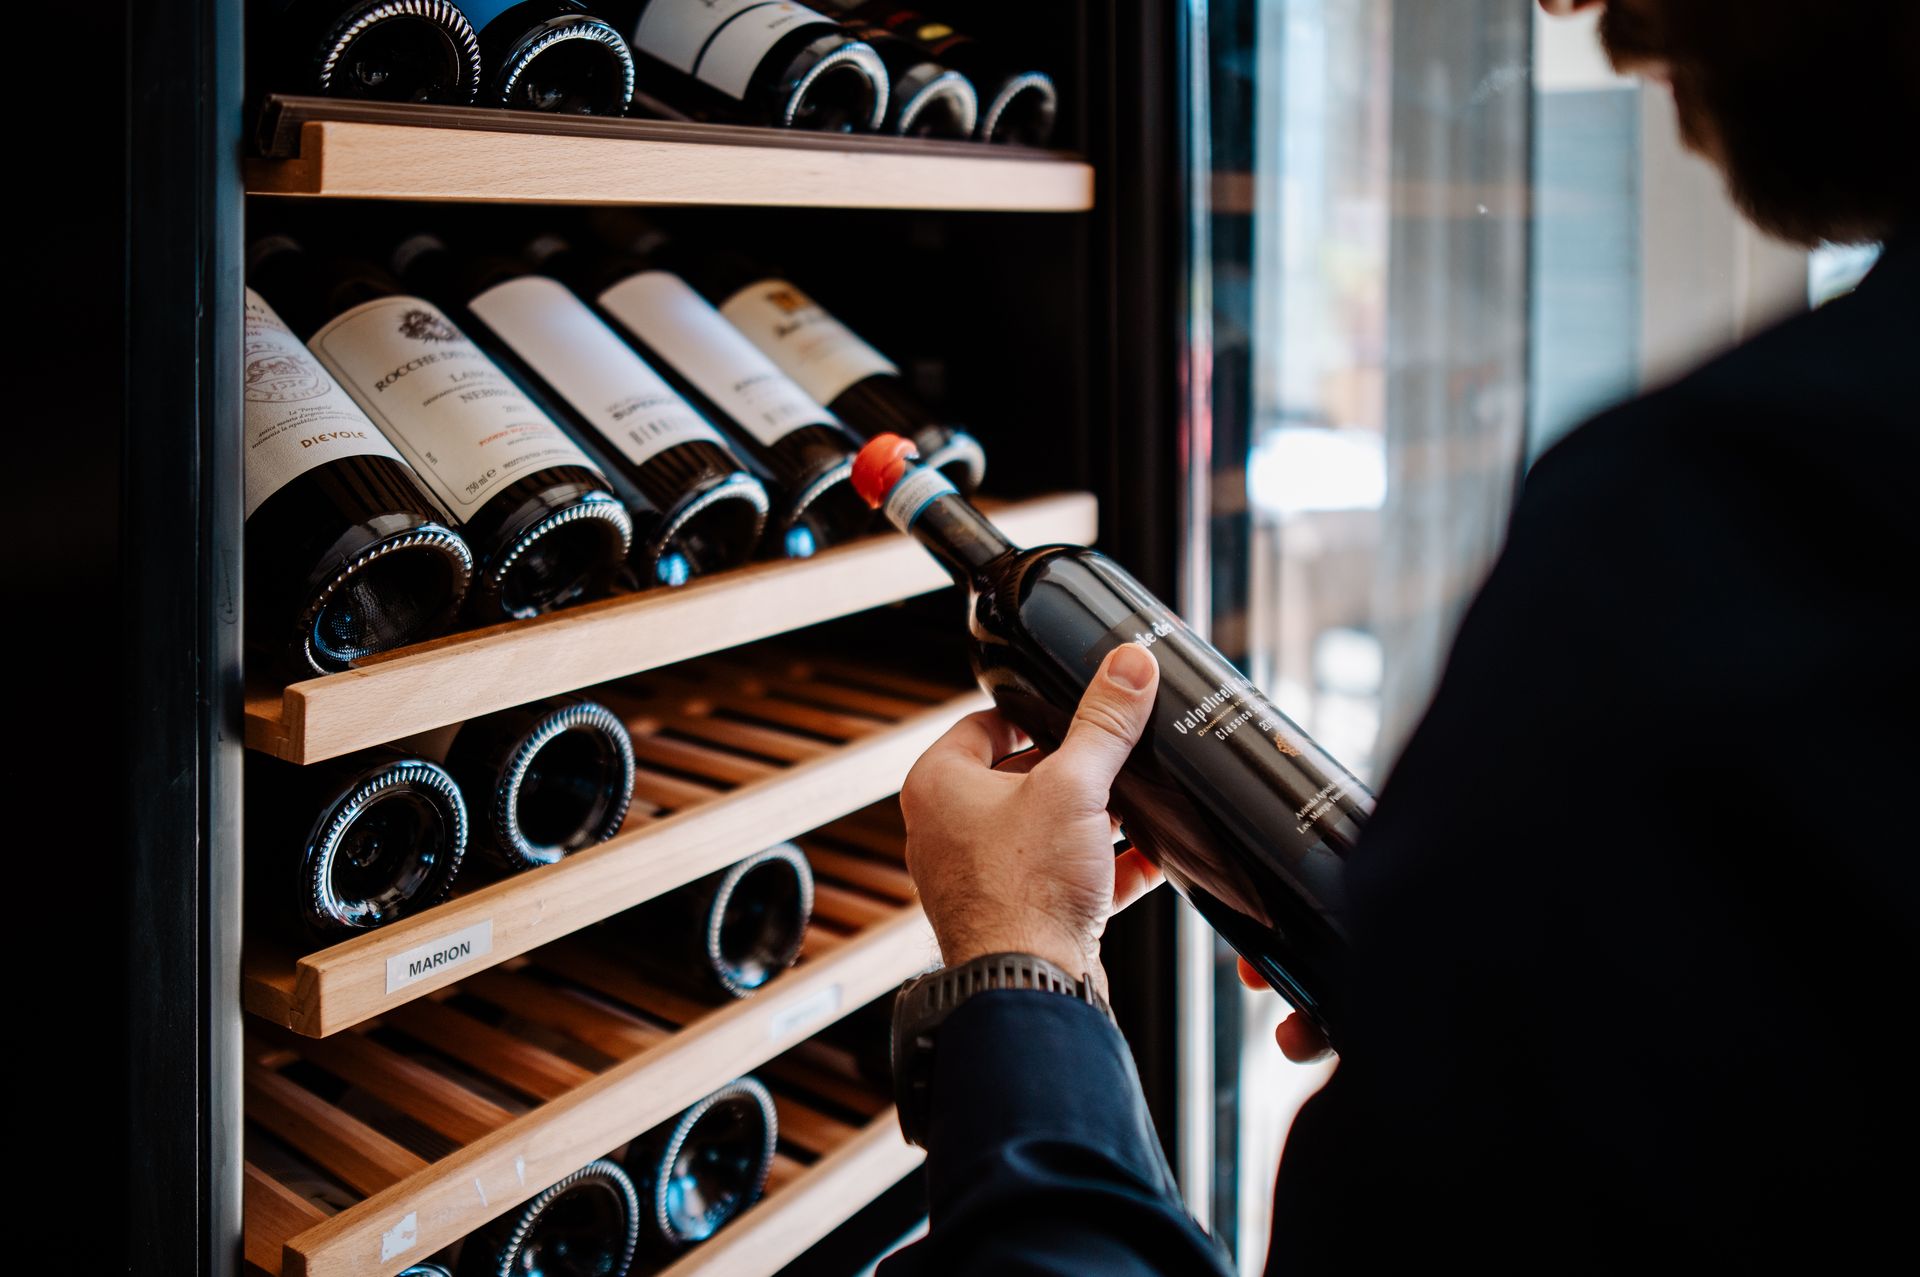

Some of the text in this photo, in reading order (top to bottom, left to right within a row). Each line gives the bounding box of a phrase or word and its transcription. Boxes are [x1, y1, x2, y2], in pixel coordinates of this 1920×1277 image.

[374, 353, 440, 392] ROCCHE
[300, 431, 368, 449] DIEVOLE
[465, 480, 480, 496] 750
[480, 474, 489, 487] ml
[1215, 710, 1253, 740] Classico
[409, 941, 471, 977] MARION
